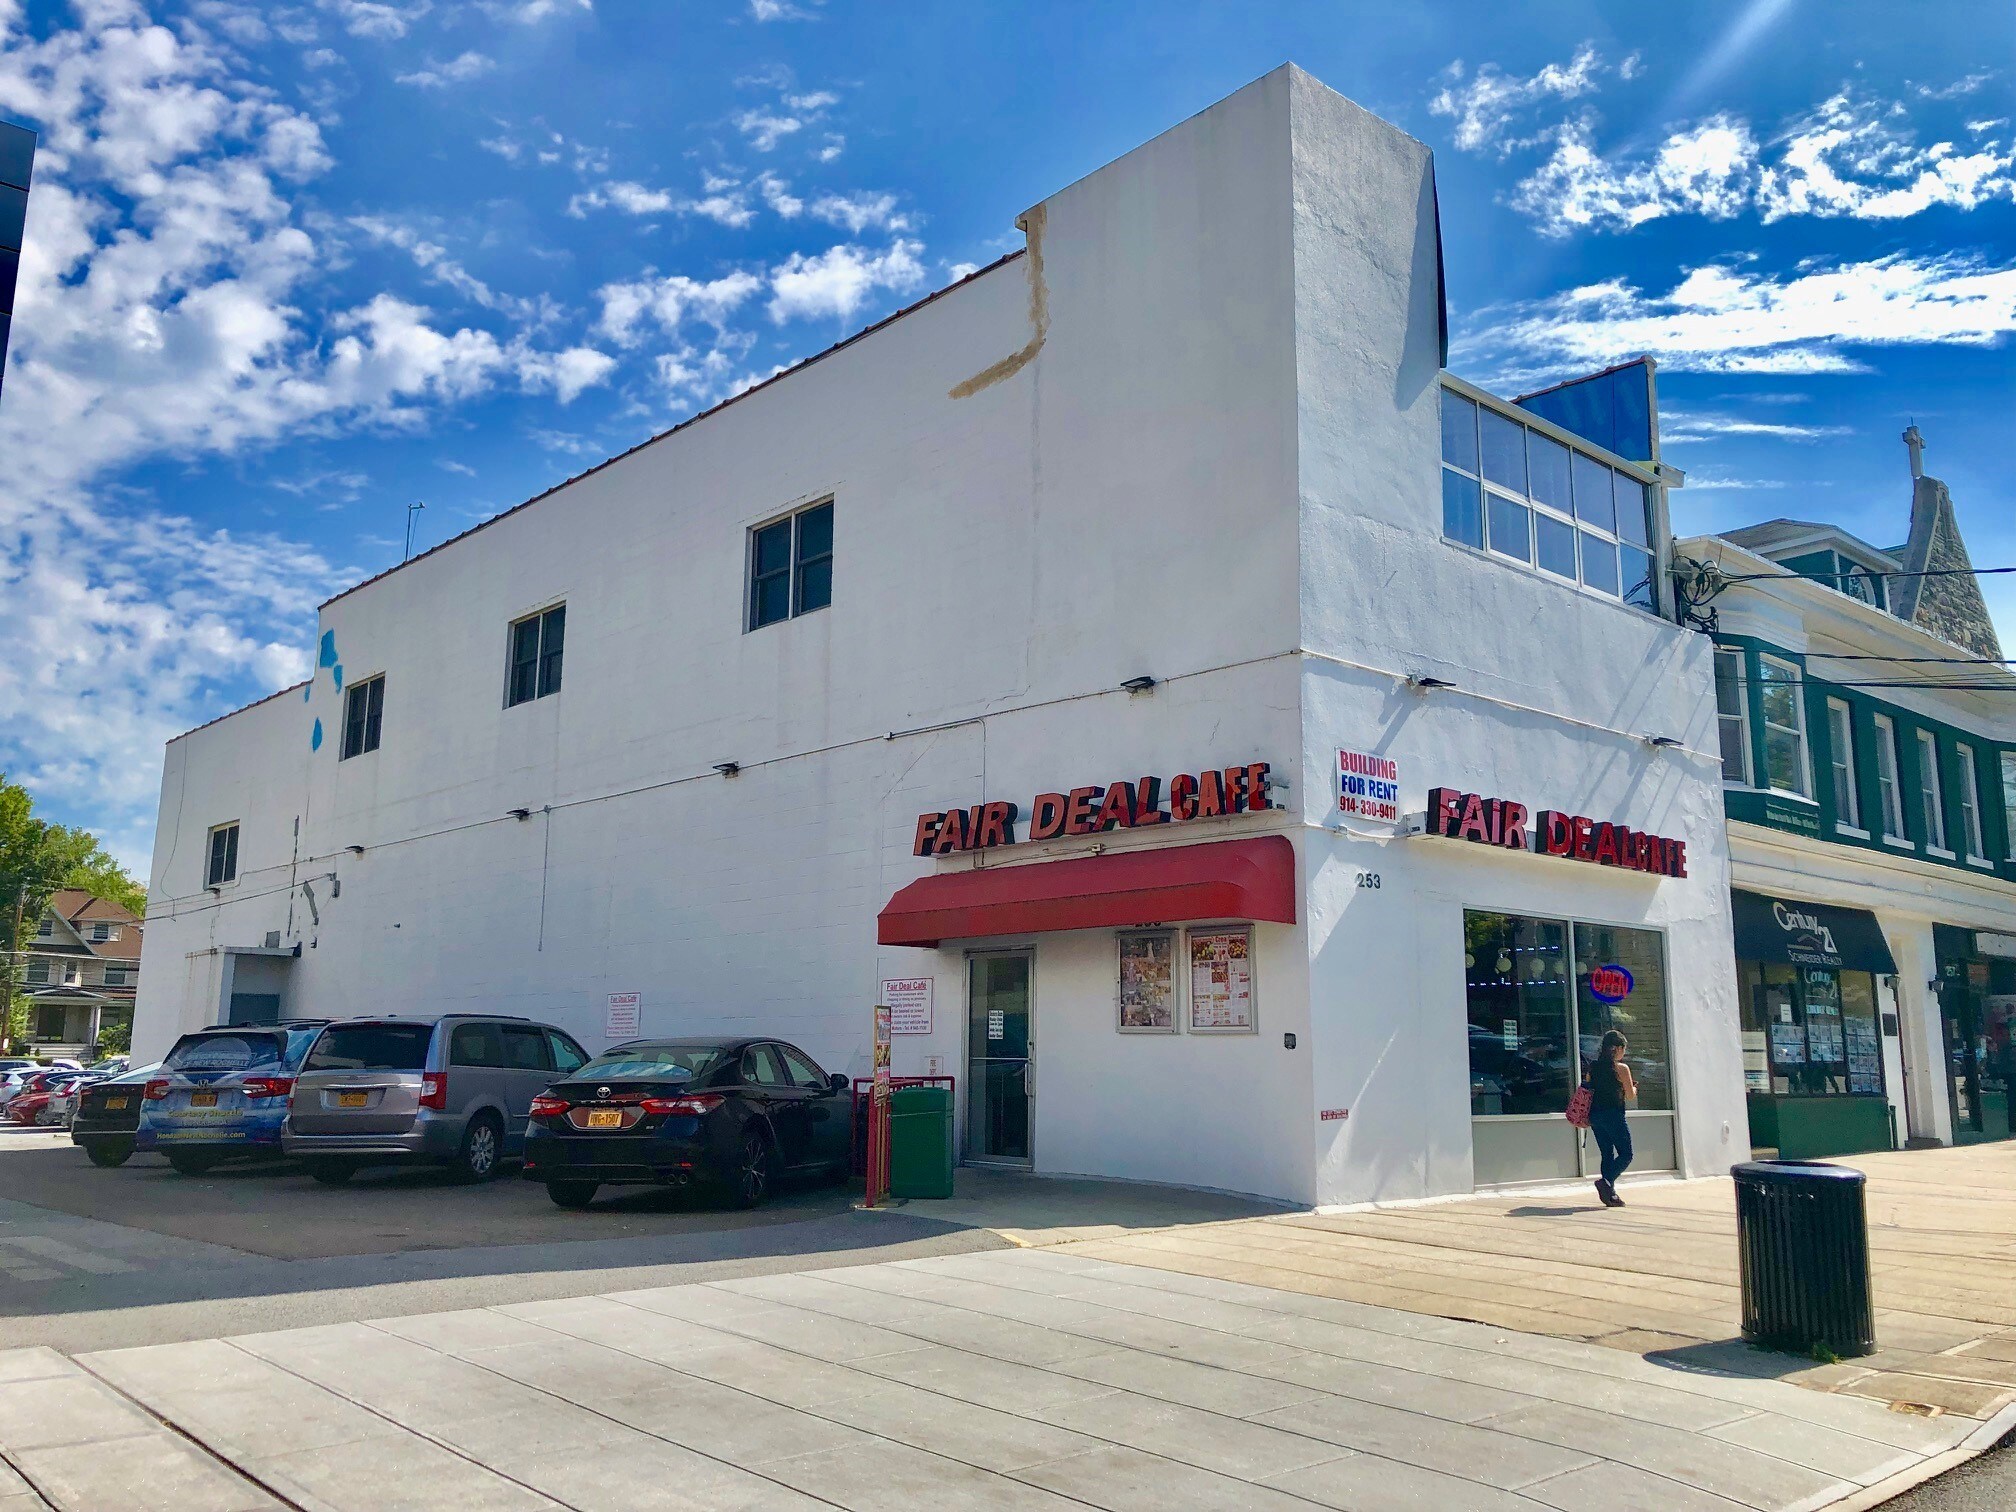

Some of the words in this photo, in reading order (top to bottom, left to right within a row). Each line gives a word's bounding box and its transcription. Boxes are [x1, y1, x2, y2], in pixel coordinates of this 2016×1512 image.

[1340, 751, 1396, 780] BUILDING
[1342, 775, 1365, 795] FOR
[1369, 779, 1397, 801] RENT
[913, 801, 1018, 856] FAIR
[1030, 776, 1171, 840] DEAL
[1171, 762, 1273, 820] CAFE
[1428, 787, 1527, 849] FAIR
[1536, 810, 1636, 868] DEAL
[1357, 873, 1380, 889] 253
[1773, 902, 1819, 934] Century
[1818, 926, 1838, 953] 21
[887, 982, 898, 990] Fair
[899, 981, 912, 990] Deal
[1592, 967, 1629, 998] OPEN
